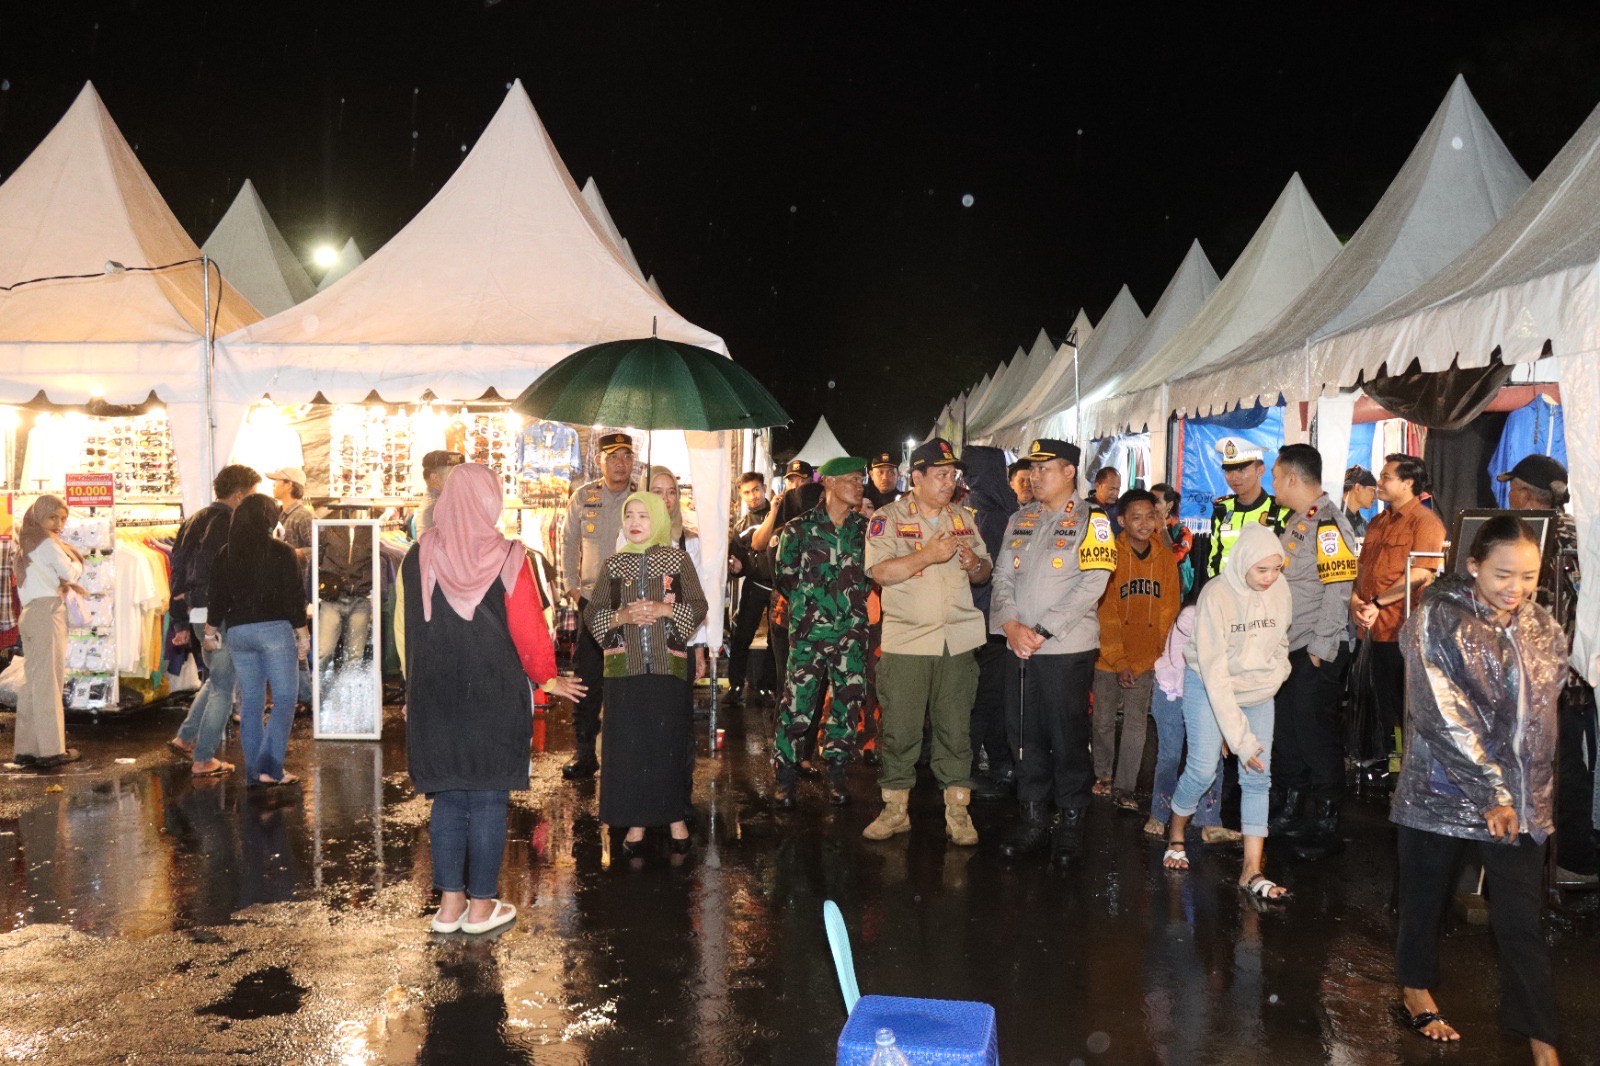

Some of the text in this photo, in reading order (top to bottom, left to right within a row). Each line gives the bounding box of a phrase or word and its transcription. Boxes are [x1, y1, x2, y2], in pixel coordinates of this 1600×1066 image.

[68, 486, 108, 496] 10.000
[1331, 559, 1346, 572] OPS
[1120, 578, 1161, 599] ERIGO
